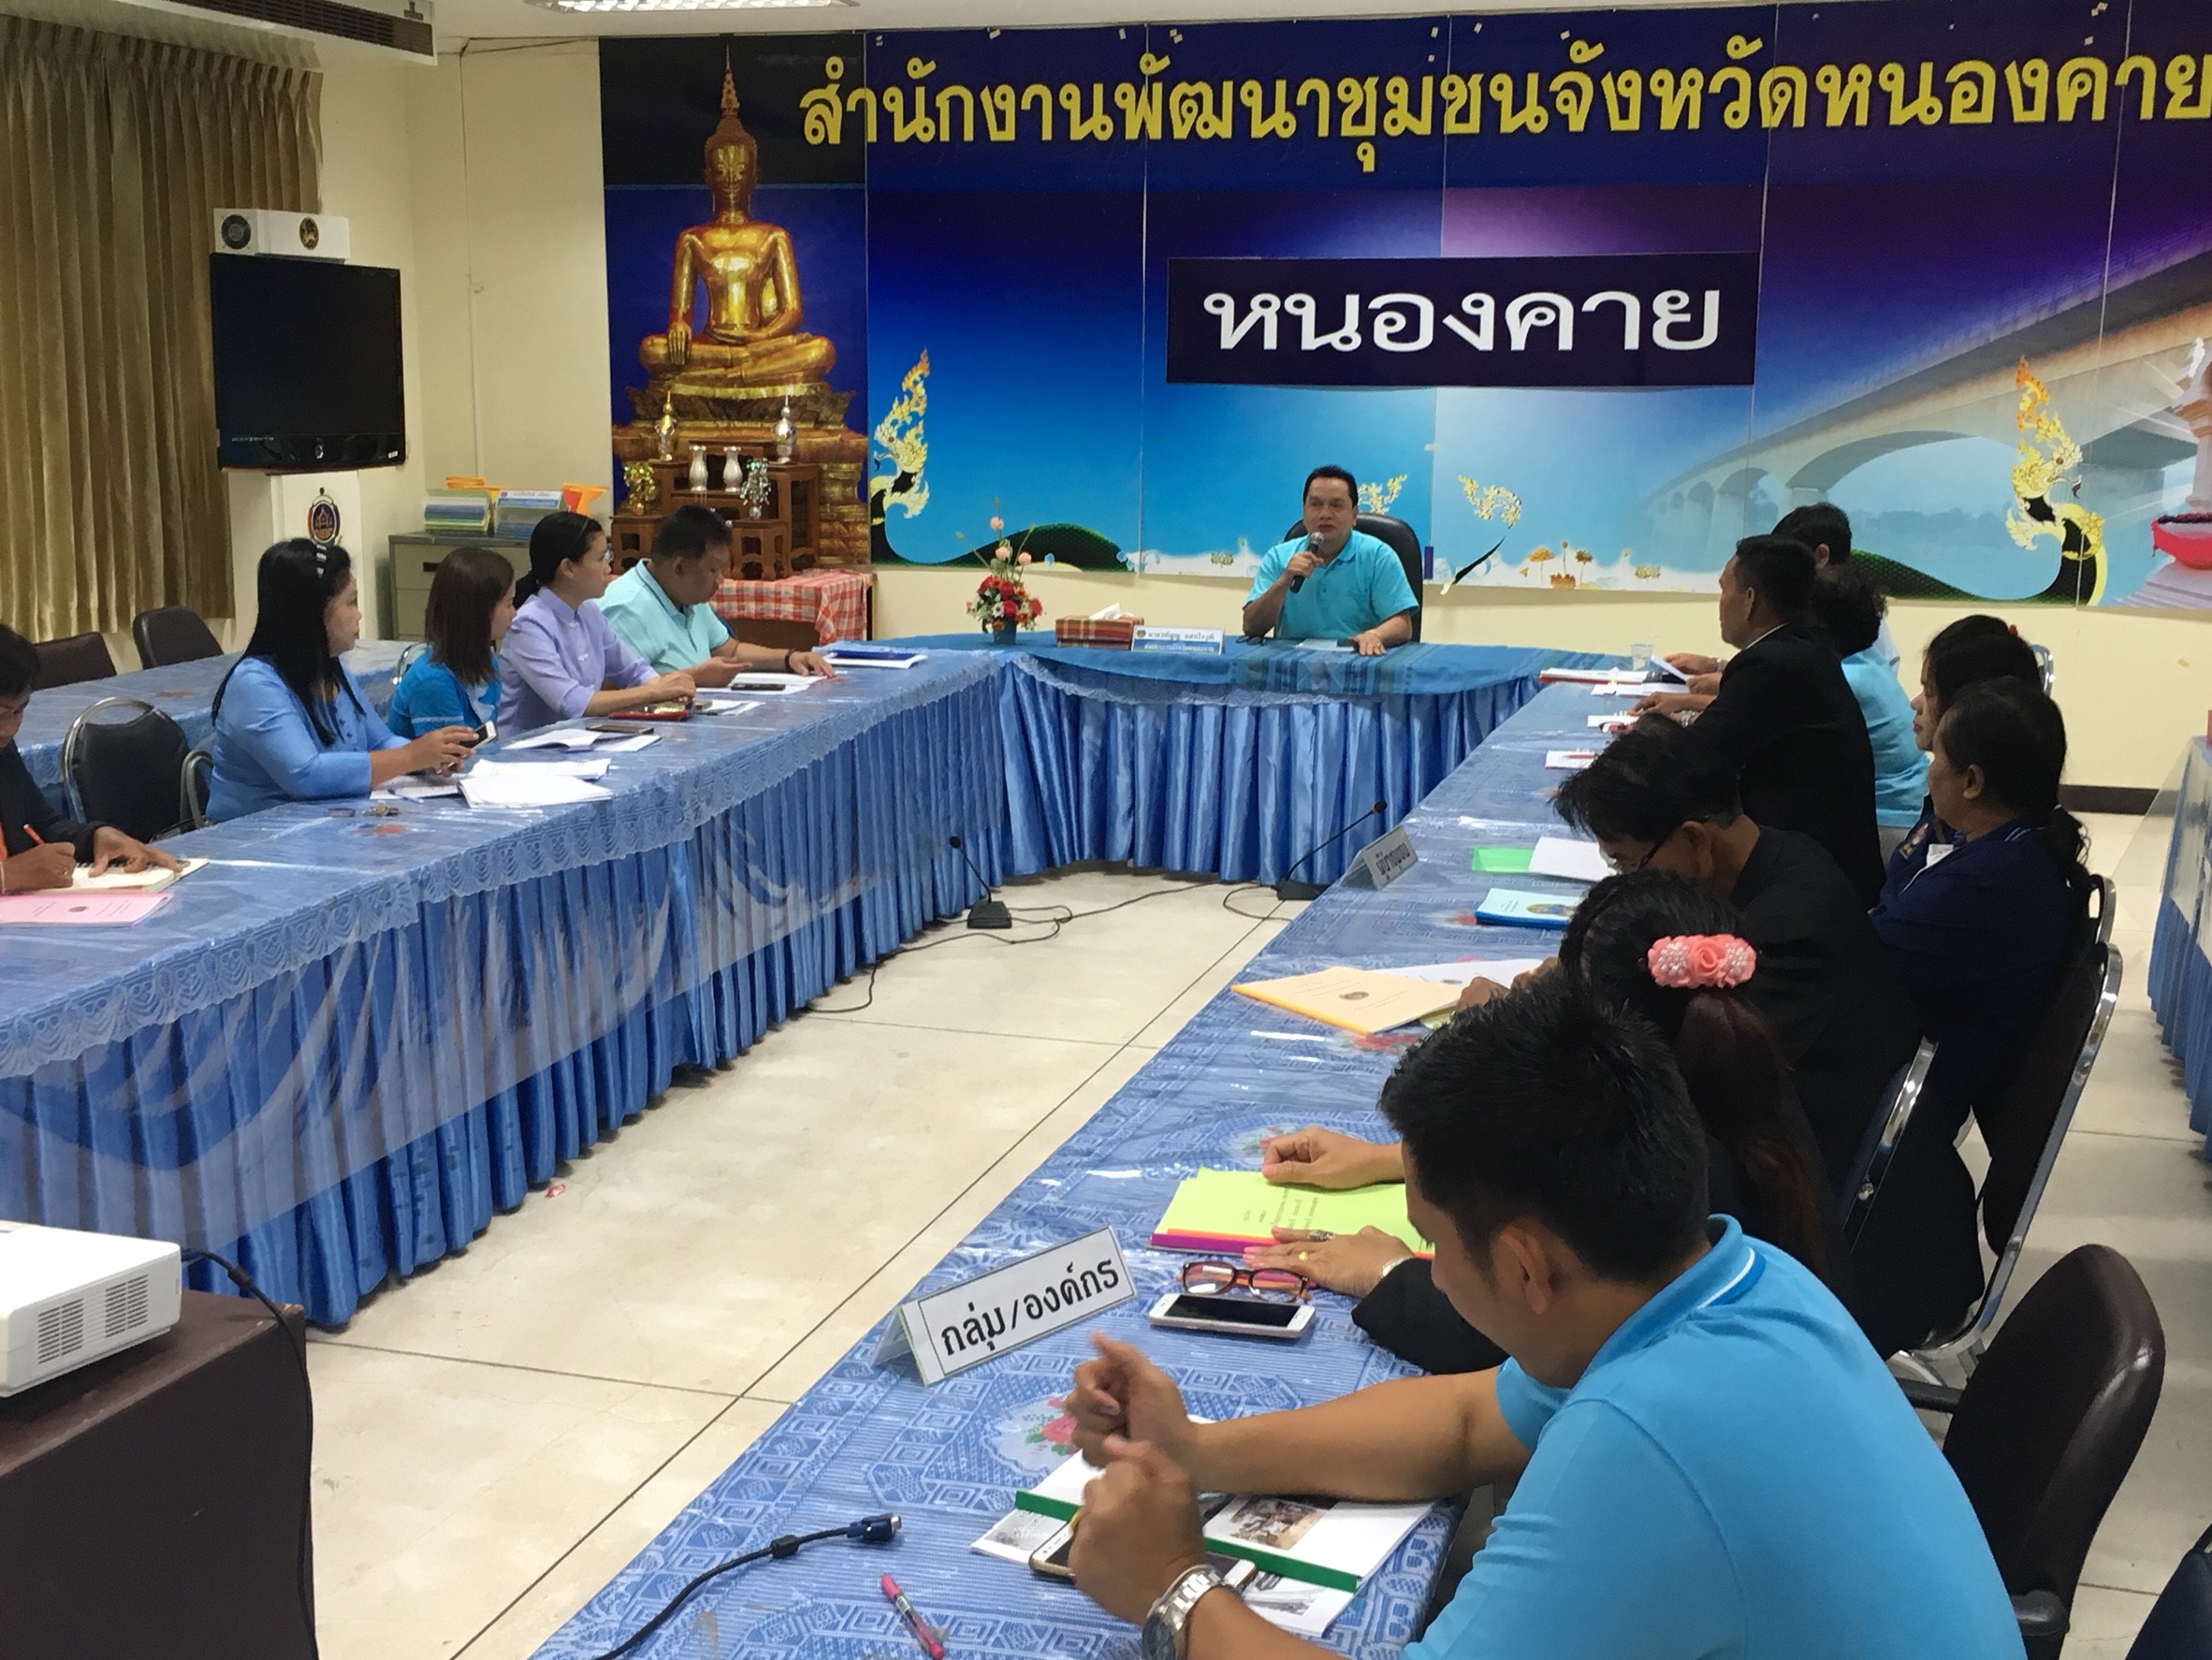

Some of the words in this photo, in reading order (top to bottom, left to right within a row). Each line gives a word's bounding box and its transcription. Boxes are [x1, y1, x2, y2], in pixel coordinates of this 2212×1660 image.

[799, 35, 2212, 172] สำนักงานพัฒนาชุมชนจังหวัดหนองคาย
[1203, 290, 1720, 352] หนองคาย
[940, 1259, 1120, 1357] กลุ่ม/องค์กร
